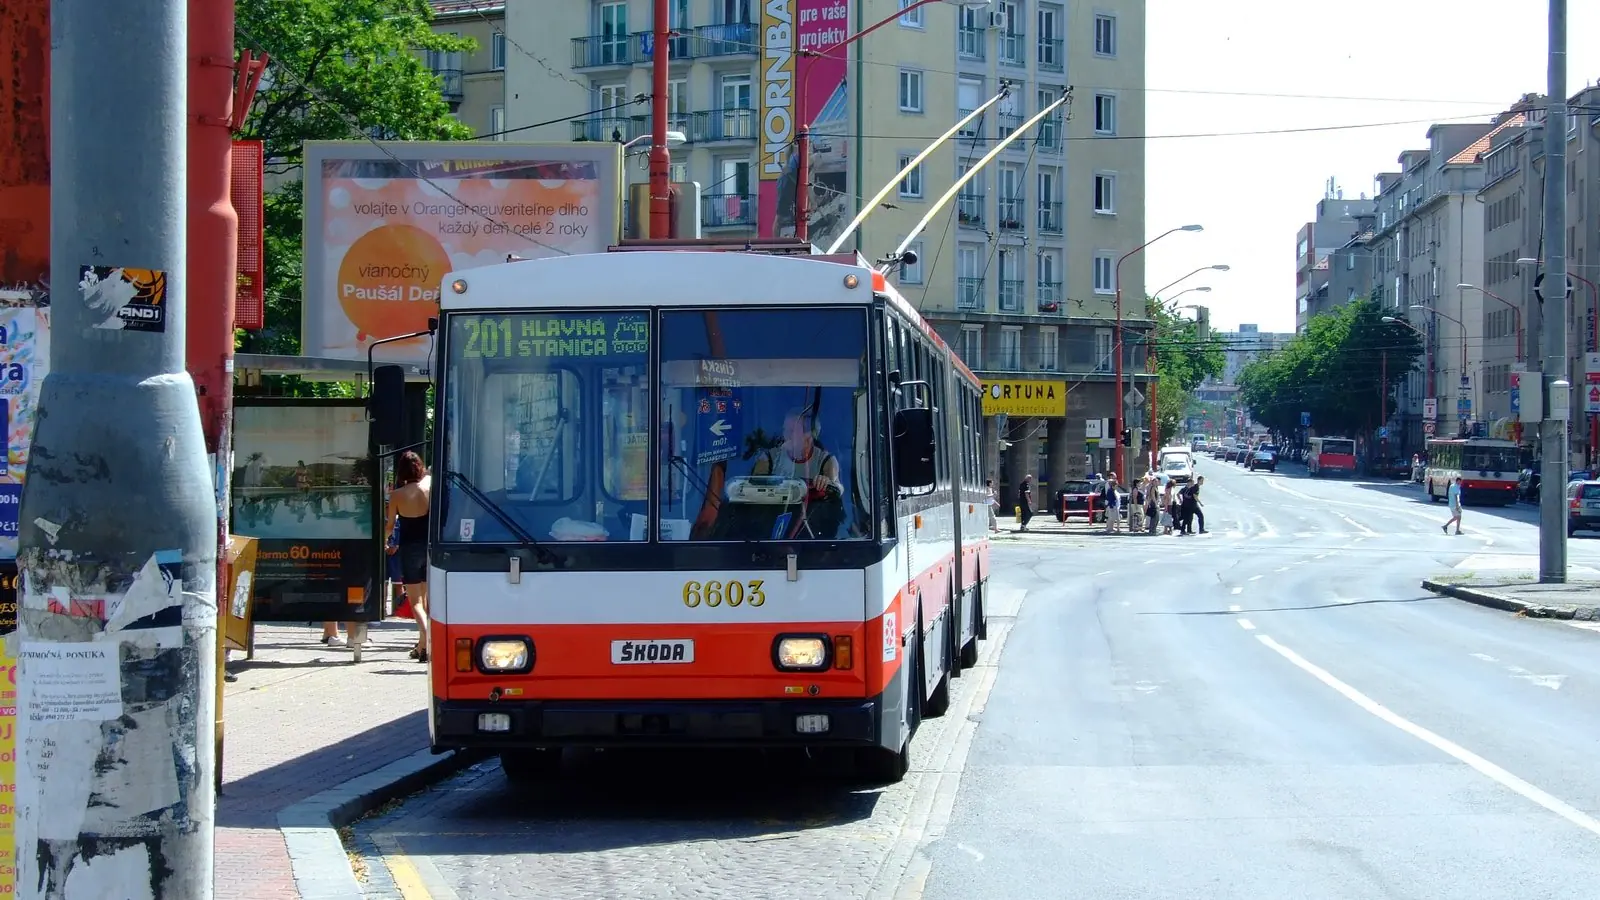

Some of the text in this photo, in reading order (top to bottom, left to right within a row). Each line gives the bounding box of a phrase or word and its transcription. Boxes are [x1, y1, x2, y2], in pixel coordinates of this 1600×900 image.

[800, 1, 847, 26] pre vaše
[800, 27, 845, 49] projekty
[354, 202, 398, 218] volajte
[402, 204, 410, 215] v
[472, 202, 555, 216] neuveriteľne
[558, 203, 589, 216] dlho
[438, 221, 589, 238] každý deň celé 2 roky
[358, 263, 430, 283] vianočný
[343, 284, 404, 301] Paušál
[119, 307, 160, 319] AND1
[463, 316, 606, 358] 201 HLAVNÁ
[518, 339, 608, 357] STANICA
[980, 384, 1055, 400] FORTUNA
[463, 522, 471, 537] 5
[290, 545, 310, 560] 60
[311, 550, 342, 560] minút
[682, 580, 766, 608] 6603
[66, 651, 105, 659] PONUKA
[620, 641, 685, 662] ŠKODA
